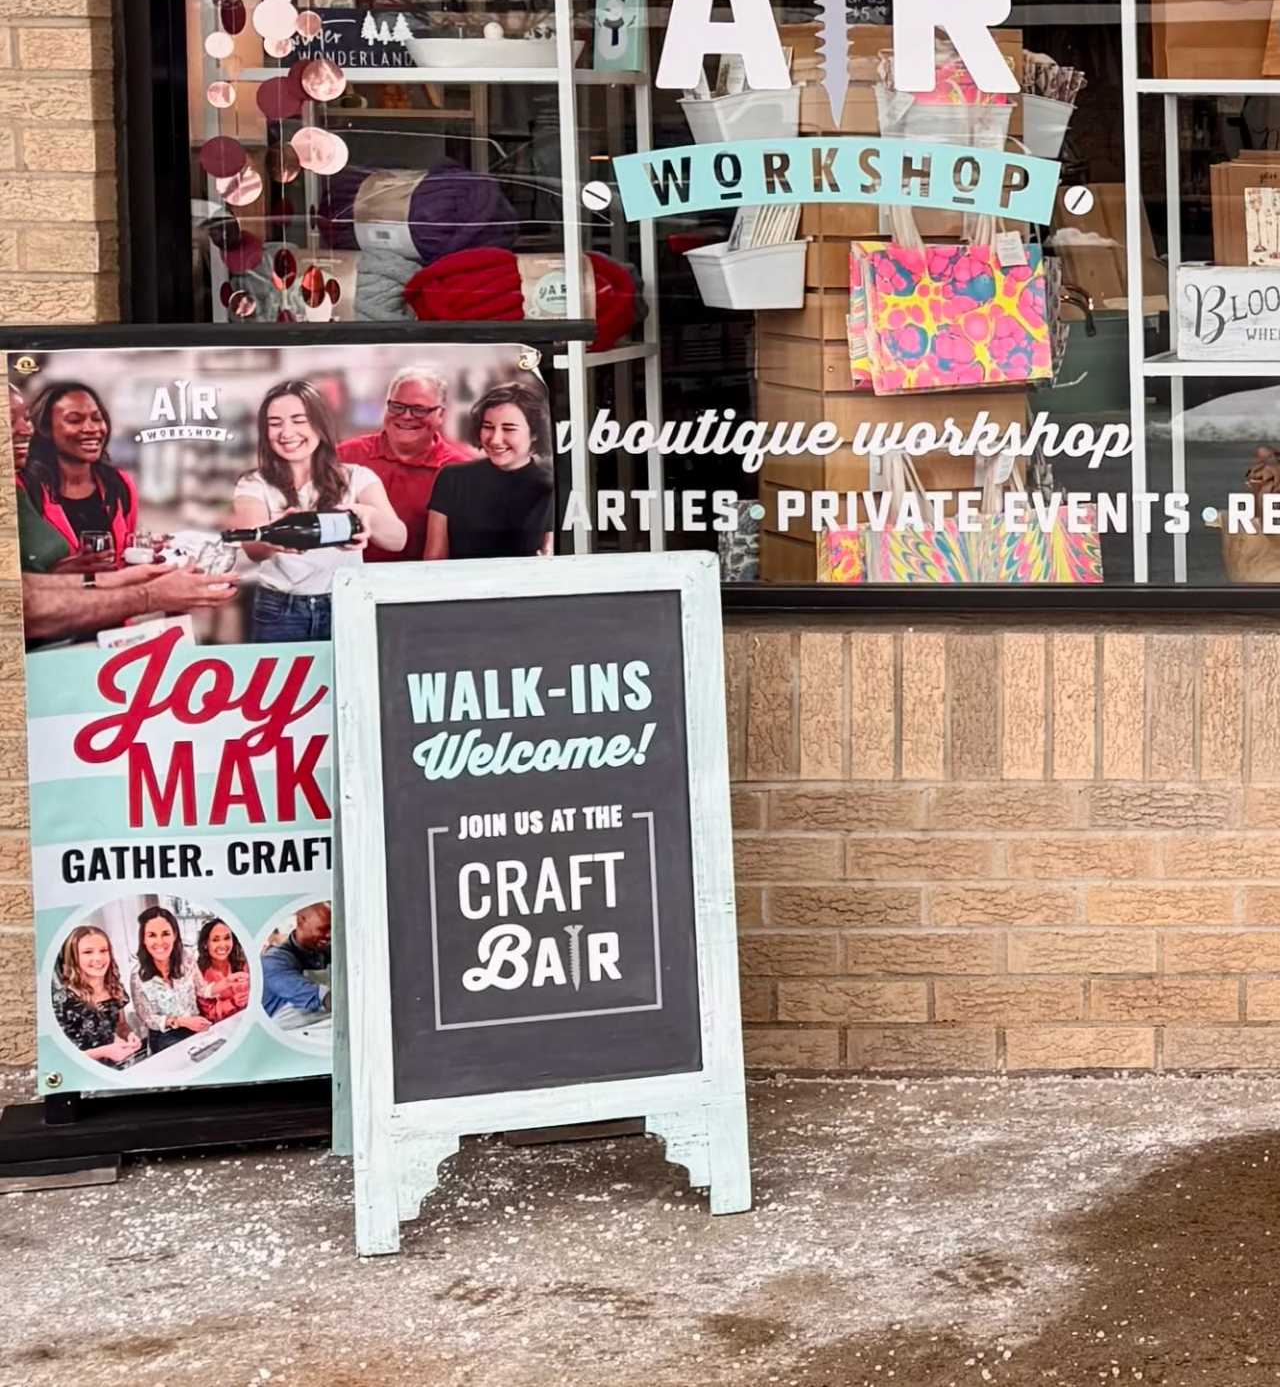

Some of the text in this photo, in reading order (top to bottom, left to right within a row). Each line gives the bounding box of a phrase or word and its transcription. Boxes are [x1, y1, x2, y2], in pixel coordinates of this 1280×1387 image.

[642, 146, 1032, 211] WORKSHOP
[587, 408, 847, 473] boutique
[852, 410, 1137, 471] workshop
[561, 489, 739, 533] ARTIES
[777, 490, 983, 534] PRIVATE
[1005, 491, 1190, 534] EVENTS
[74, 625, 329, 764] Joy
[407, 659, 653, 725] WALK-INS
[126, 734, 331, 829] MAK
[412, 722, 656, 781] Welcome!
[459, 805, 624, 840] JOIN US AT THE
[61, 841, 214, 884] GATHER.
[458, 850, 625, 921] CRAFT
